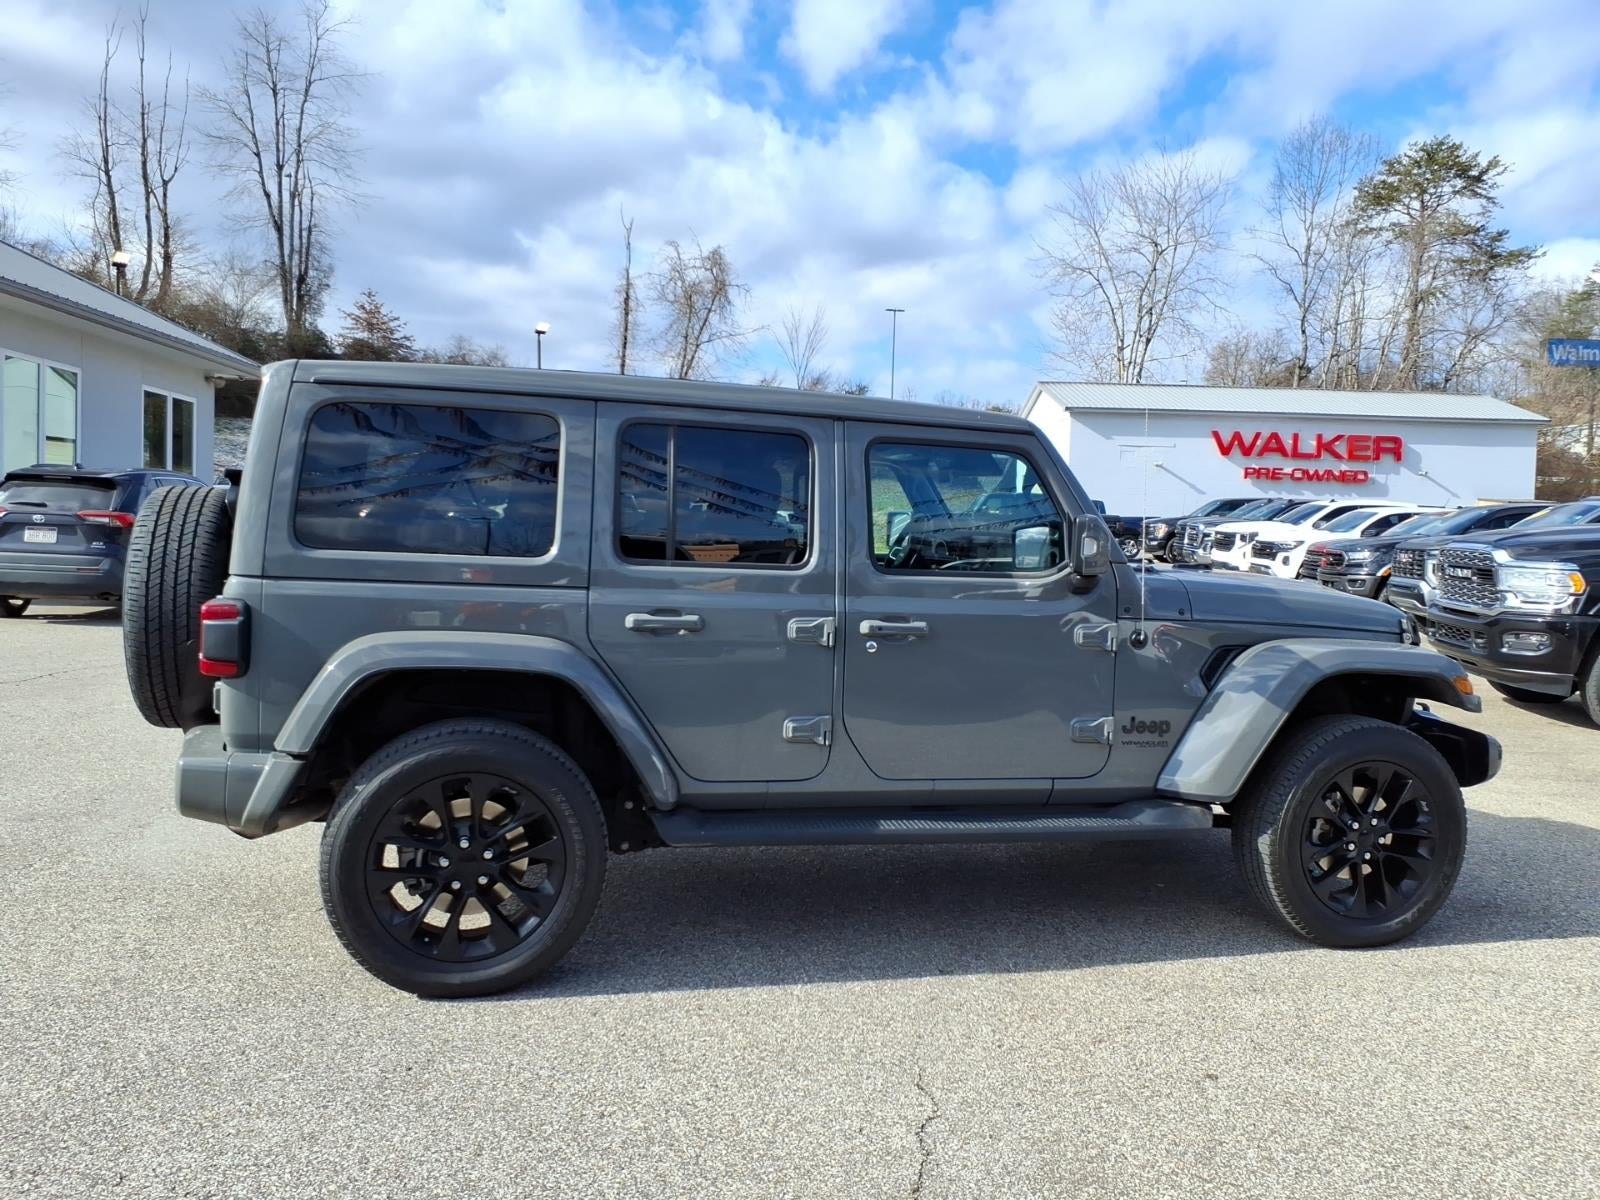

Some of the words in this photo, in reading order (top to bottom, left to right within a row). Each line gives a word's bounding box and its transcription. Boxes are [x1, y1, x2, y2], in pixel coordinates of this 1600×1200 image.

[1211, 430, 1403, 462] WALKER
[1243, 466, 1369, 483] PRE-OWNED
[1445, 567, 1472, 578] RAM
[1121, 716, 1170, 737] Jeep
